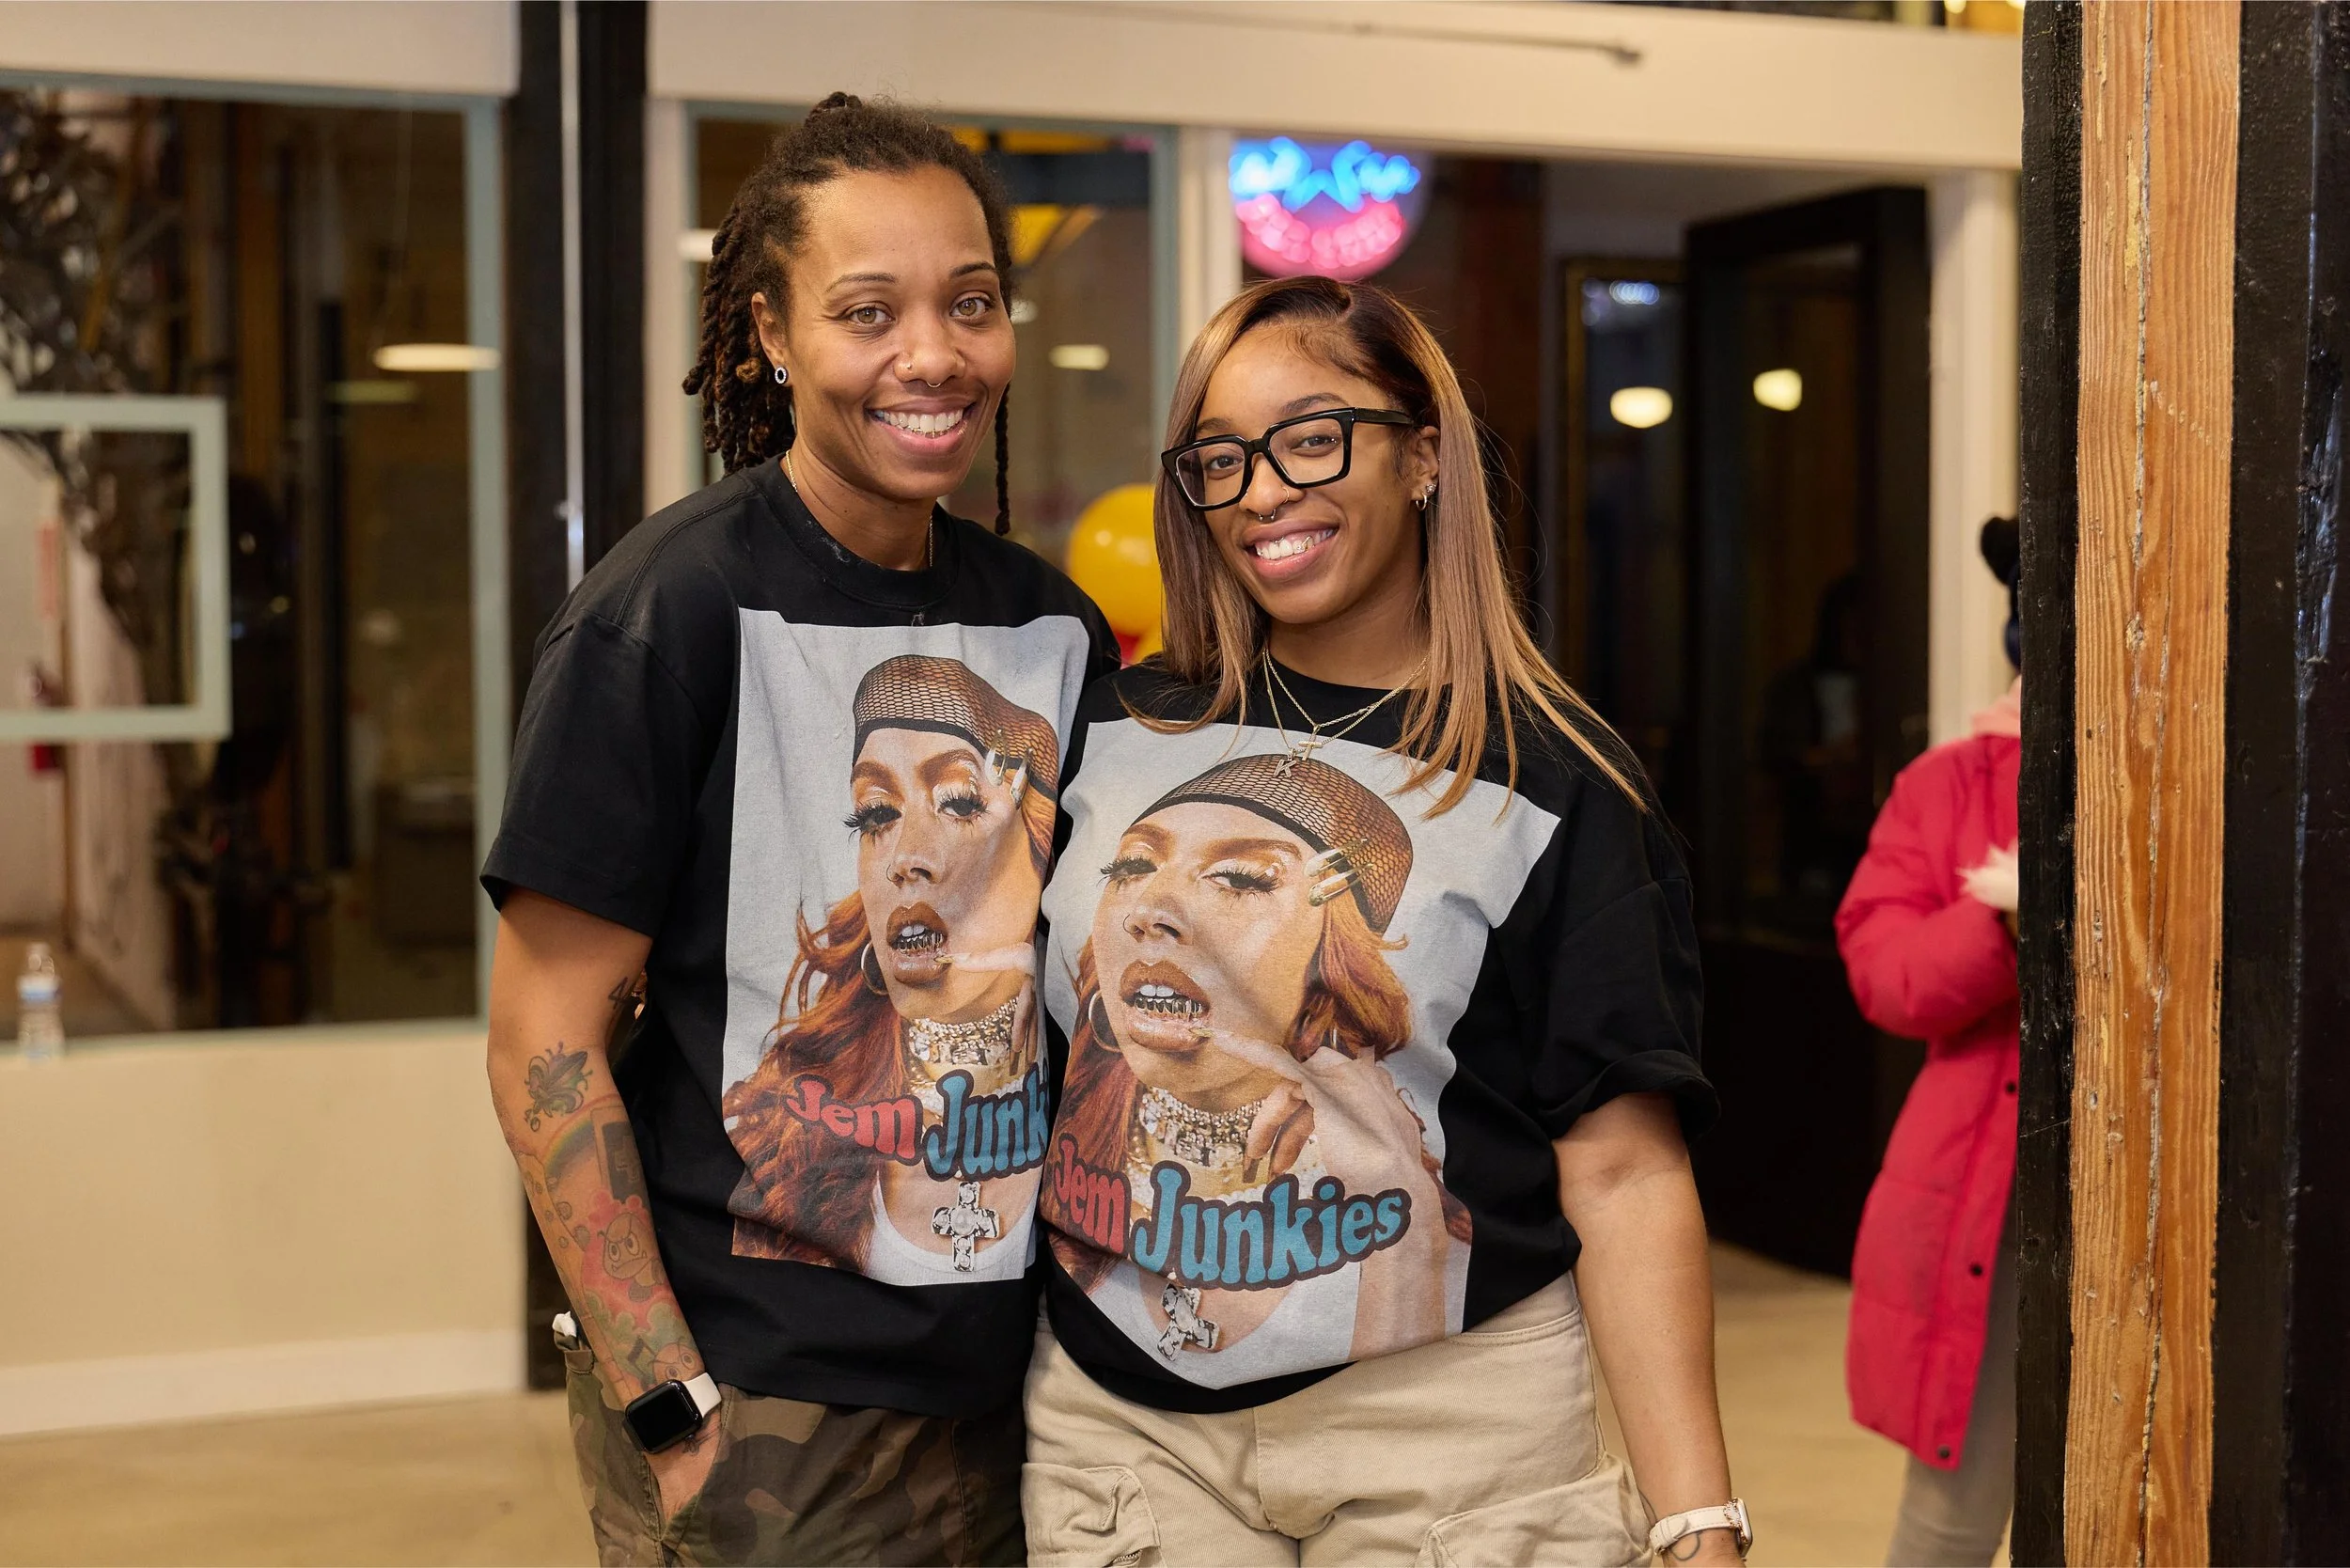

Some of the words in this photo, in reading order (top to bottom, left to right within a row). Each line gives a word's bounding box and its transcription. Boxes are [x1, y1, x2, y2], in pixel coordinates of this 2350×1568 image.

[1274, 760, 1296, 777] K
[784, 1075, 918, 1163] Jem
[924, 1065, 1049, 1175] Junk
[1054, 1137, 1128, 1256] Jem
[1132, 1166, 1403, 1285] Junkies
